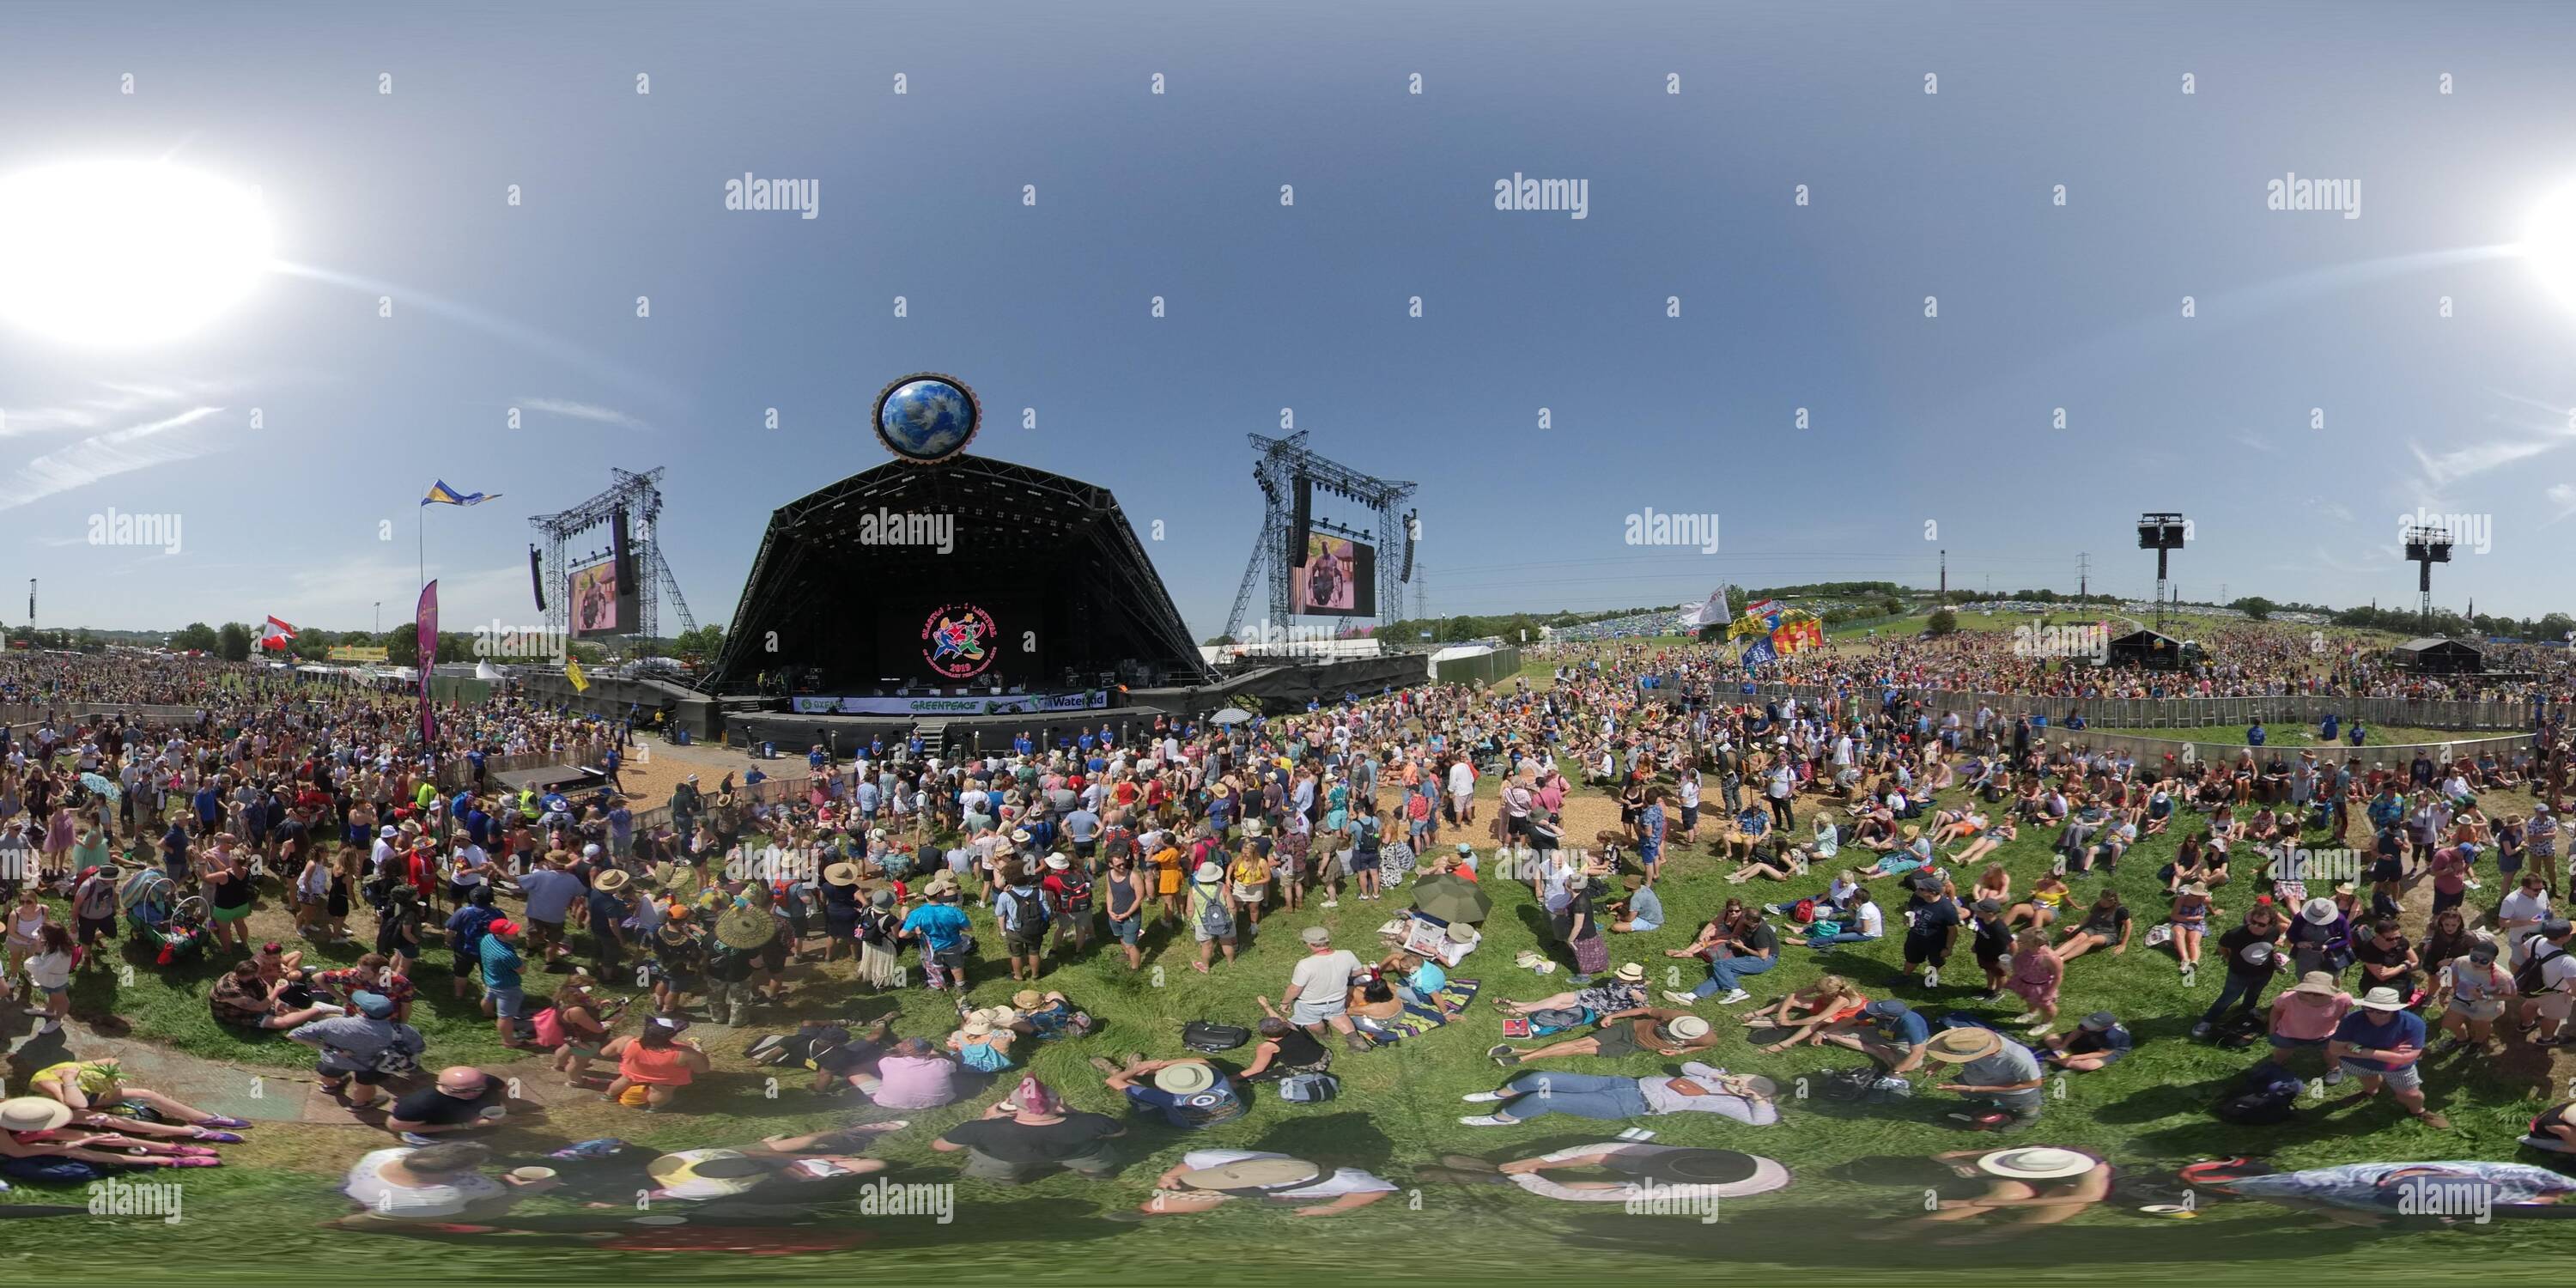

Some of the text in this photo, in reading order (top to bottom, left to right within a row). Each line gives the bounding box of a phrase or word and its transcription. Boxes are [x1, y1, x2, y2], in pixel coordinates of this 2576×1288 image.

[949, 662, 972, 672] 2019
[910, 700, 979, 711] GREENPEACE
[1053, 695, 1104, 708] Waterid
